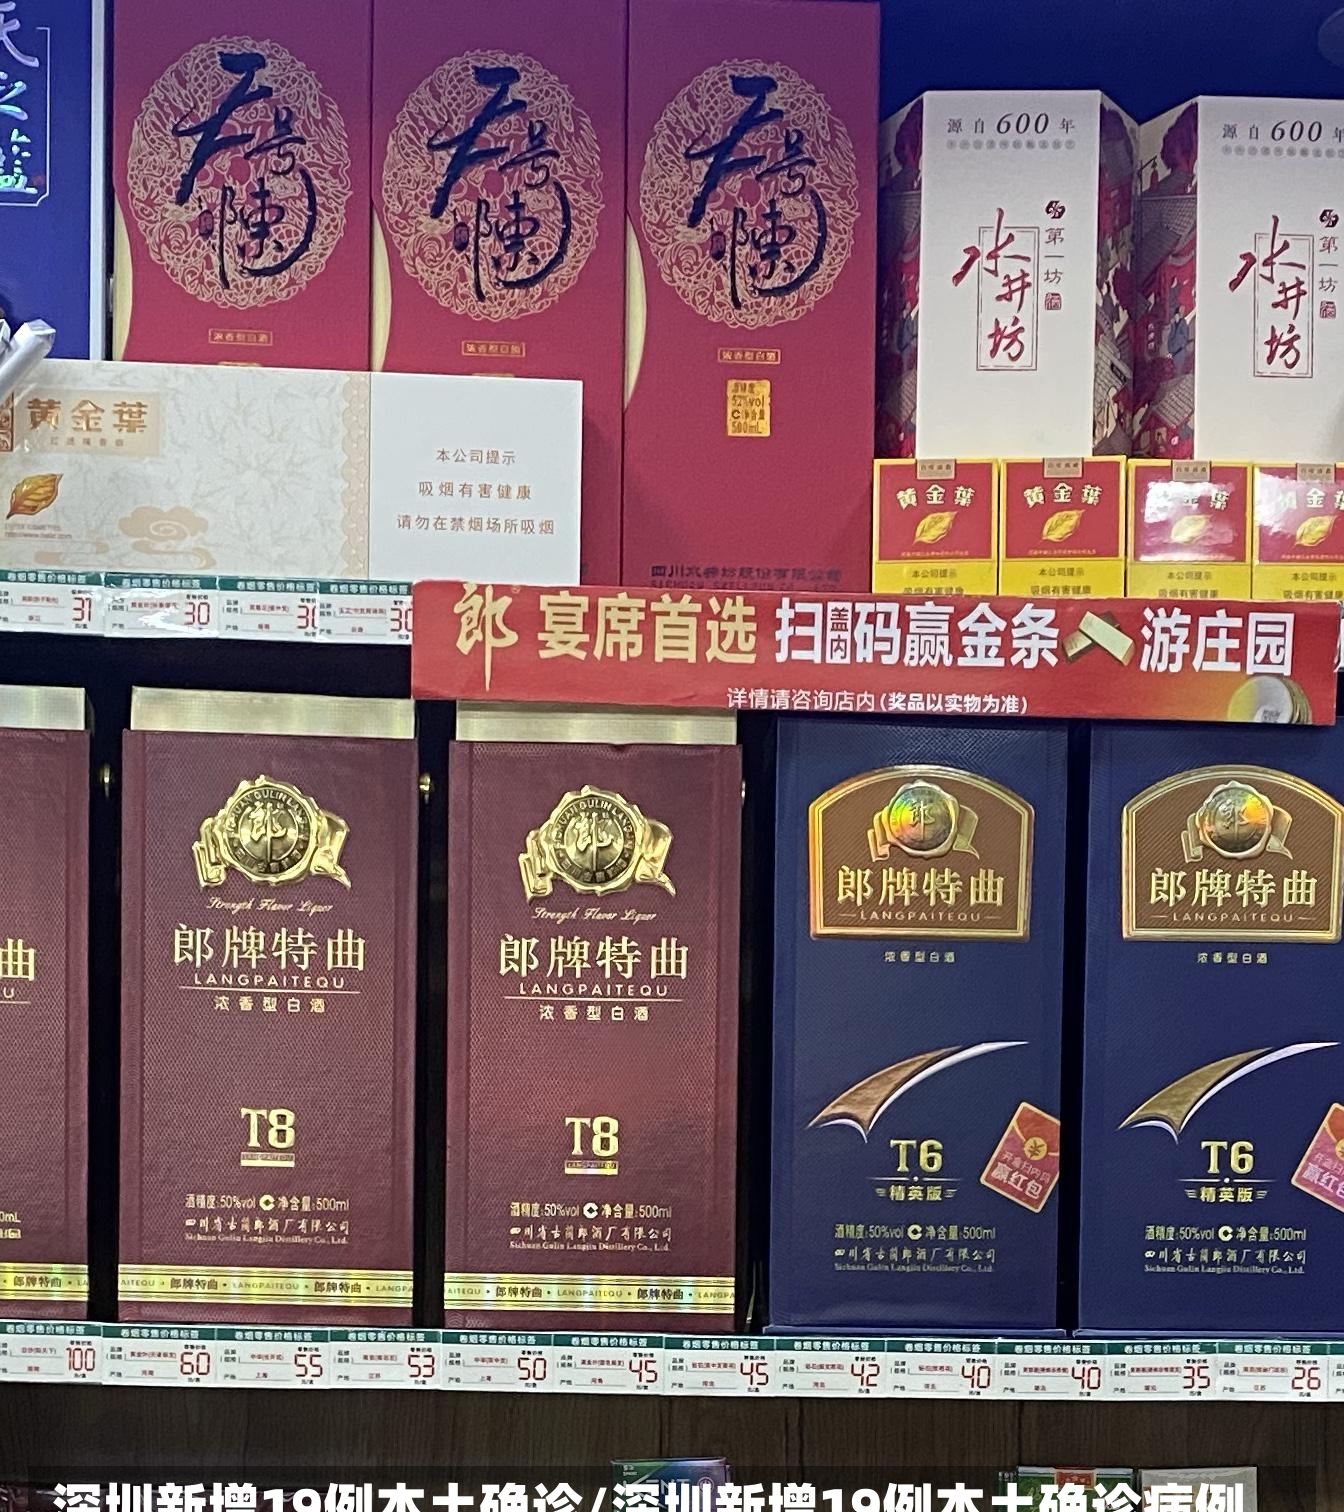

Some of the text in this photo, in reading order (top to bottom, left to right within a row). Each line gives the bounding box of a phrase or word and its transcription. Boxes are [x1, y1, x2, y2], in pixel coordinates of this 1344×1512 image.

[947, 111, 1076, 136] 源自600年
[1044, 226, 1065, 285] 第一坊
[1318, 236, 1339, 294] 第一坊
[952, 207, 1032, 362] 水井坊
[1228, 215, 1308, 370] 水井坊
[436, 448, 516, 465] 本公司提示
[418, 481, 533, 501] 吸烟有害健康
[396, 514, 555, 536] 请勿在禁烟场所吸烟
[72, 597, 93, 622] 31
[184, 601, 210, 626] 30
[453, 582, 1295, 692] 郎 宴席首选 游庄园
[727, 687, 1029, 715] 详情请咨询店内 (奖品以实物为准)
[837, 866, 1004, 908] 郎牌特曲
[1149, 867, 1318, 908] 郎牌特曲
[173, 922, 366, 973] 郎牌特曲
[498, 932, 690, 980] 郎牌特曲
[193, 973, 346, 990] LANGPAITEQU
[518, 982, 669, 998] LANGPAITEQU
[214, 994, 326, 1014] 浓香型白酒
[539, 1003, 650, 1022] 浓香型白酒
[240, 1107, 296, 1151] T8
[889, 1138, 944, 1173] T6
[890, 1184, 943, 1202] 精英版
[1199, 1186, 1254, 1203] 精英版
[180, 1351, 211, 1376] 60
[294, 1354, 323, 1378] 55
[408, 1354, 435, 1378] 53
[517, 1357, 547, 1381] 50
[629, 1360, 658, 1383] 45
[740, 1362, 769, 1386] 45
[850, 1363, 880, 1387] 42
[961, 1365, 991, 1389] 40
[1183, 1366, 1211, 1389] 35
[1291, 1367, 1321, 1390] 26
